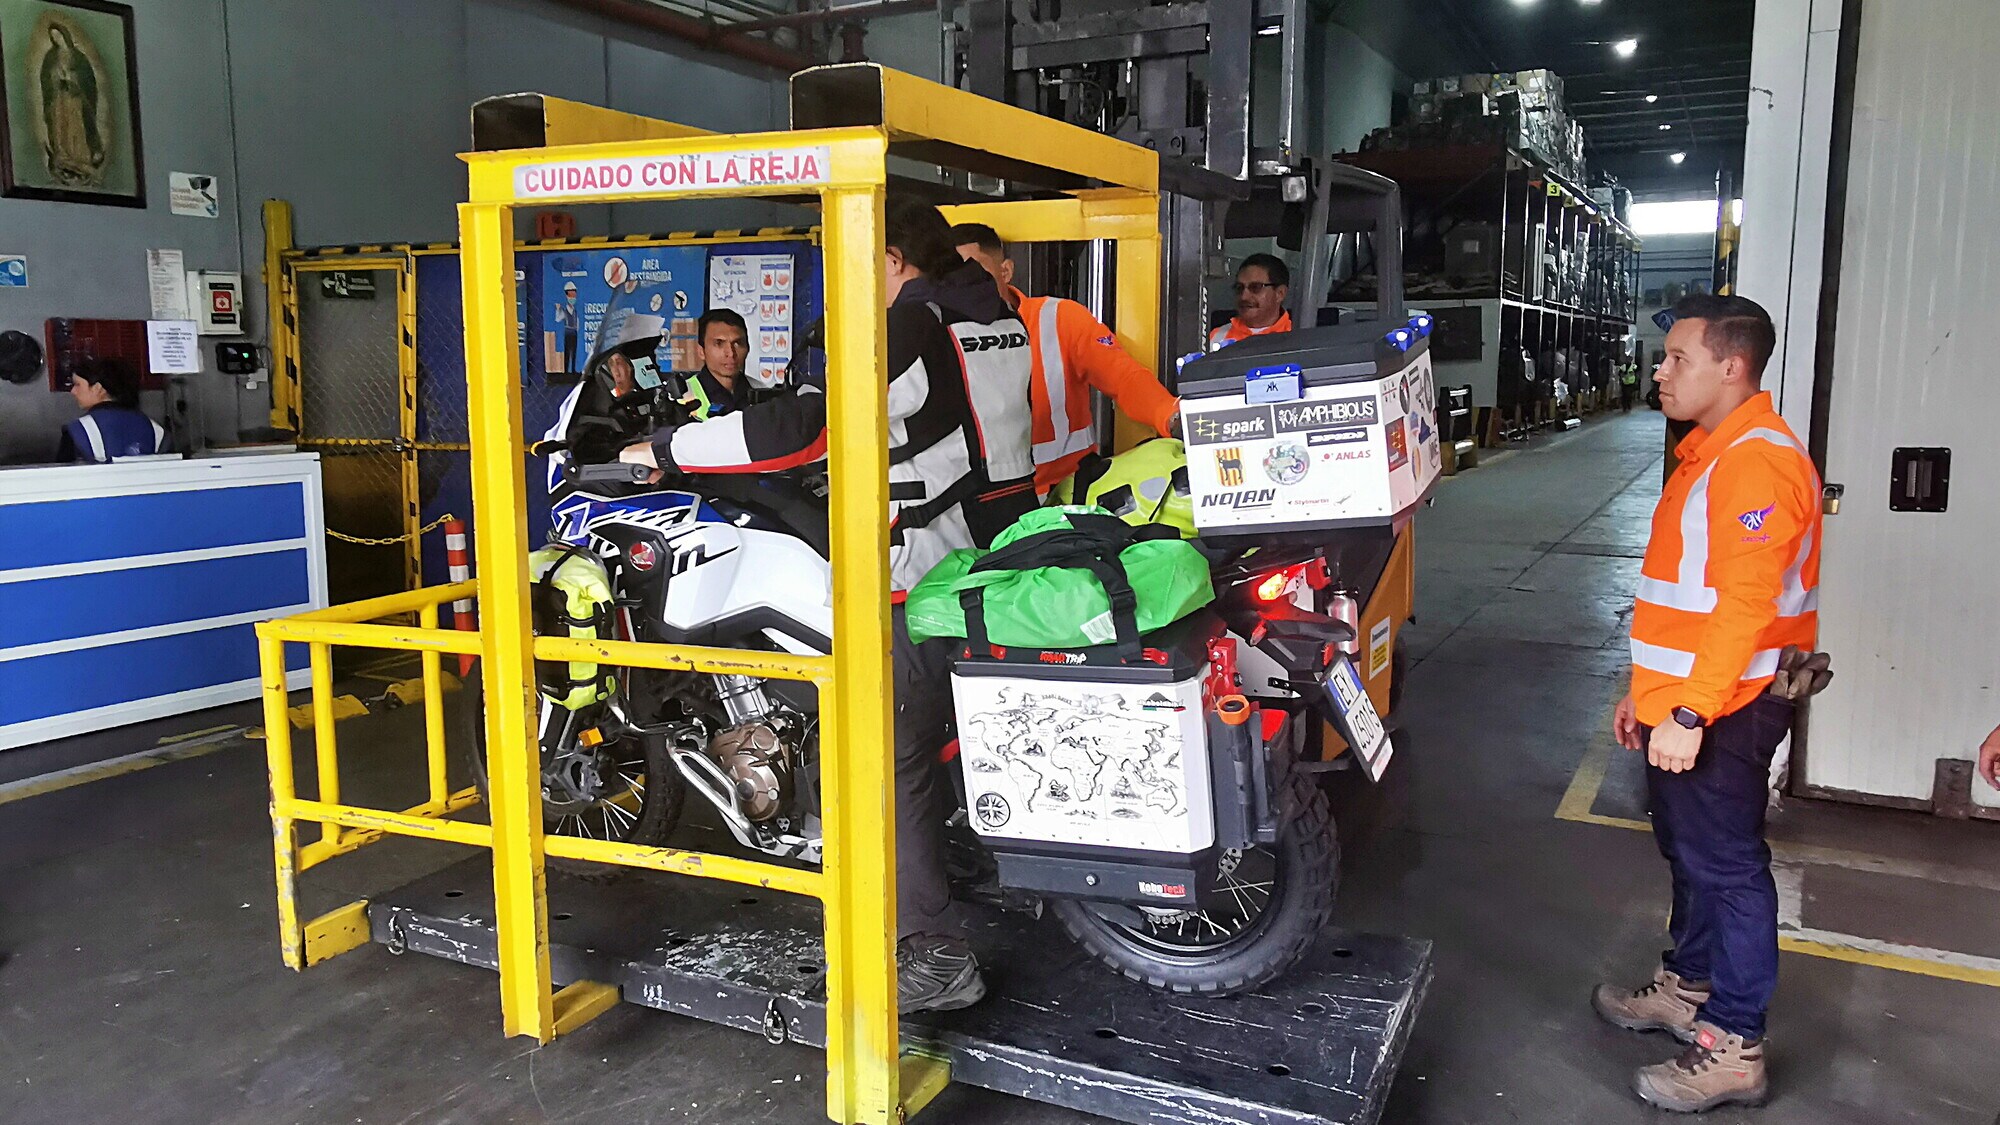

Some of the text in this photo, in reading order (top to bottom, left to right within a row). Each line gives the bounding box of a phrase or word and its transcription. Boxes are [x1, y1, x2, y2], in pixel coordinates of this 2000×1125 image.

[524, 155, 820, 192] CUIDADO CON LA REJA
[1550, 185, 1557, 194] 3
[959, 333, 1029, 352] SPID
[1297, 400, 1374, 423] AMPHIBIOUS
[1223, 416, 1265, 437] spark
[1335, 450, 1371, 461] ANLAS
[1201, 488, 1276, 509] NOLAN
[1334, 671, 1354, 706] EY
[1352, 698, 1380, 749] 45015
